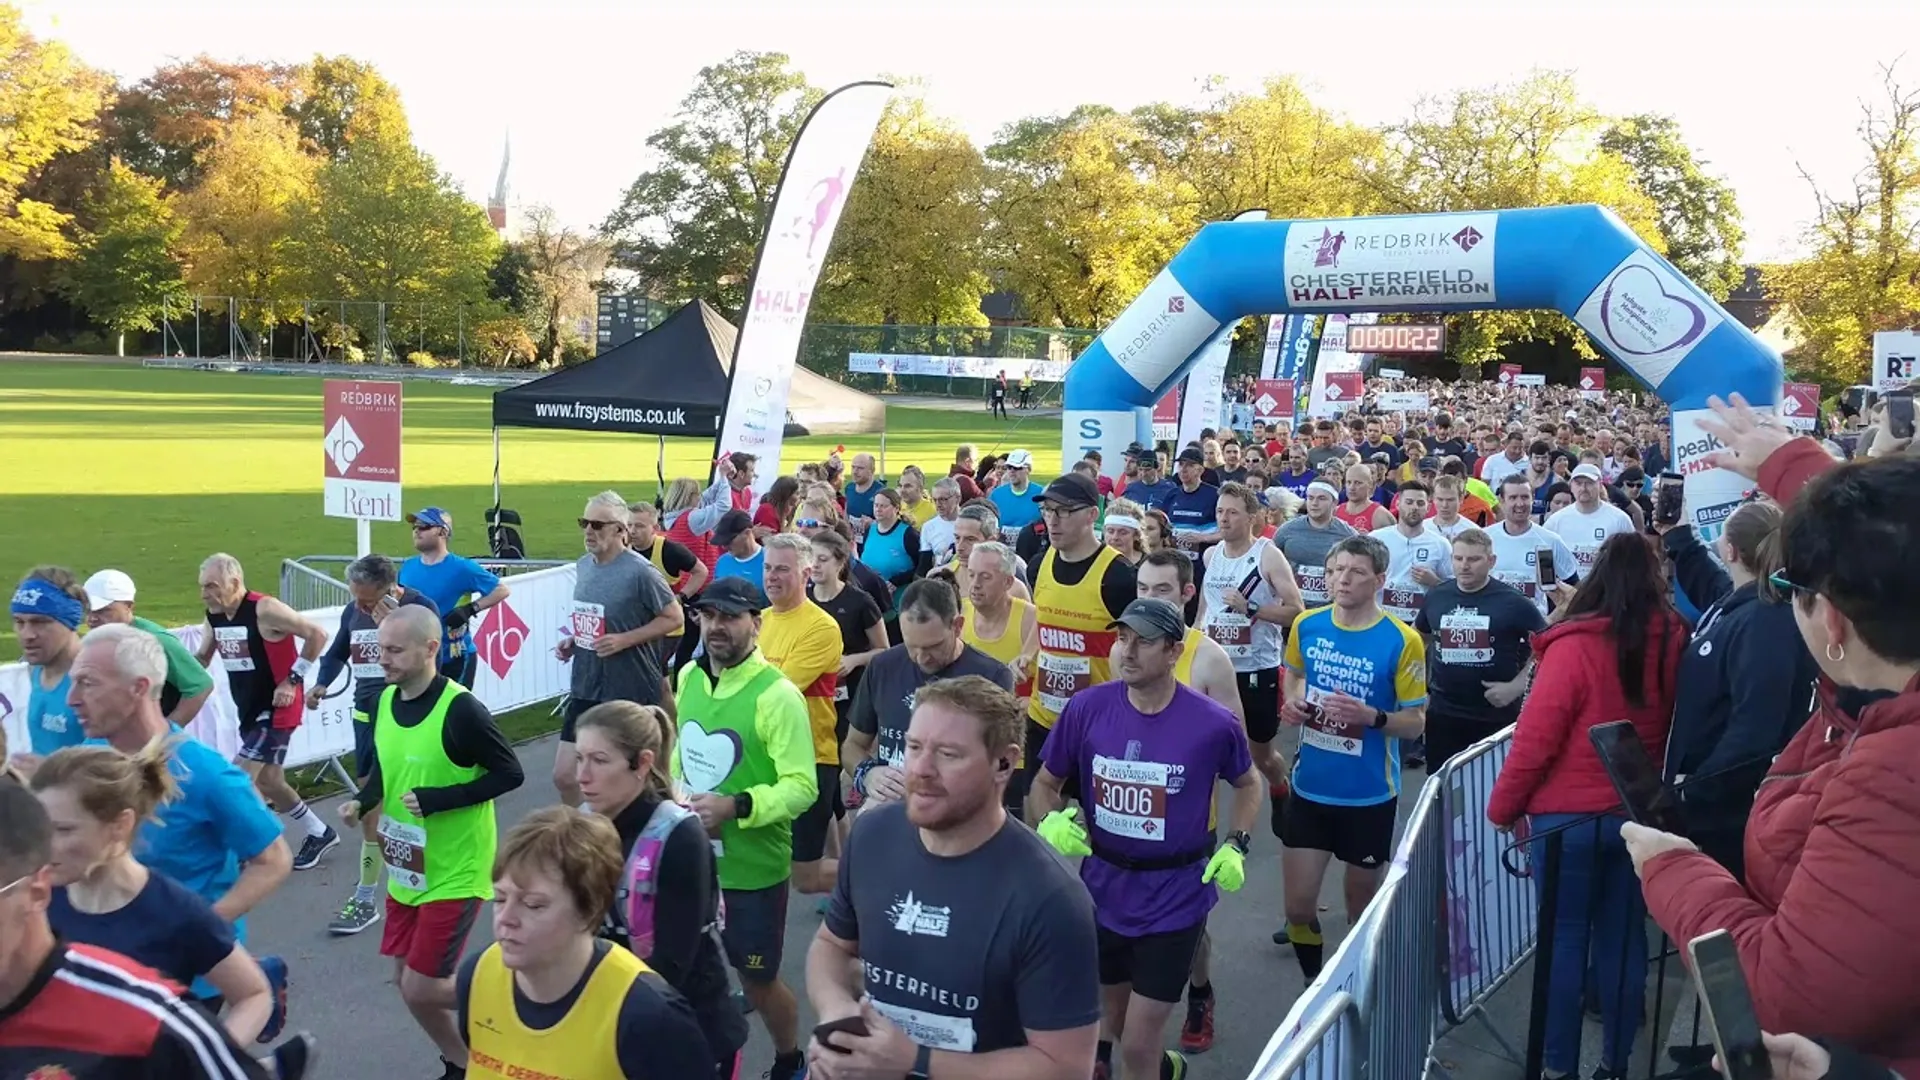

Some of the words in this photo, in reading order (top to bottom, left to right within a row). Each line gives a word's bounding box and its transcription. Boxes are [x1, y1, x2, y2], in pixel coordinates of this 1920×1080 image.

[1354, 232, 1451, 250] REDBRIK
[1290, 269, 1474, 289] CHESTERFIELD
[755, 289, 810, 314] HALF
[1293, 287, 1363, 301] HALF
[1369, 282, 1490, 297] MARATHON
[1117, 309, 1171, 364] REDBRIK
[1321, 337, 1346, 348] HAL
[1352, 327, 1440, 351] 00:00:22
[341, 391, 396, 406] REDBRIK
[535, 401, 686, 426] www.frsystems.co.uk
[344, 486, 394, 518] Rent
[575, 614, 600, 636] 5062
[1450, 629, 1476, 643] 2510
[1040, 627, 1085, 653] CHRIS
[1316, 637, 1335, 649] The
[1306, 646, 1374, 671] Children's
[1046, 671, 1075, 691] 2738
[1313, 660, 1374, 684] Hospital
[1317, 673, 1369, 699] Charity
[1102, 781, 1153, 816] 3006
